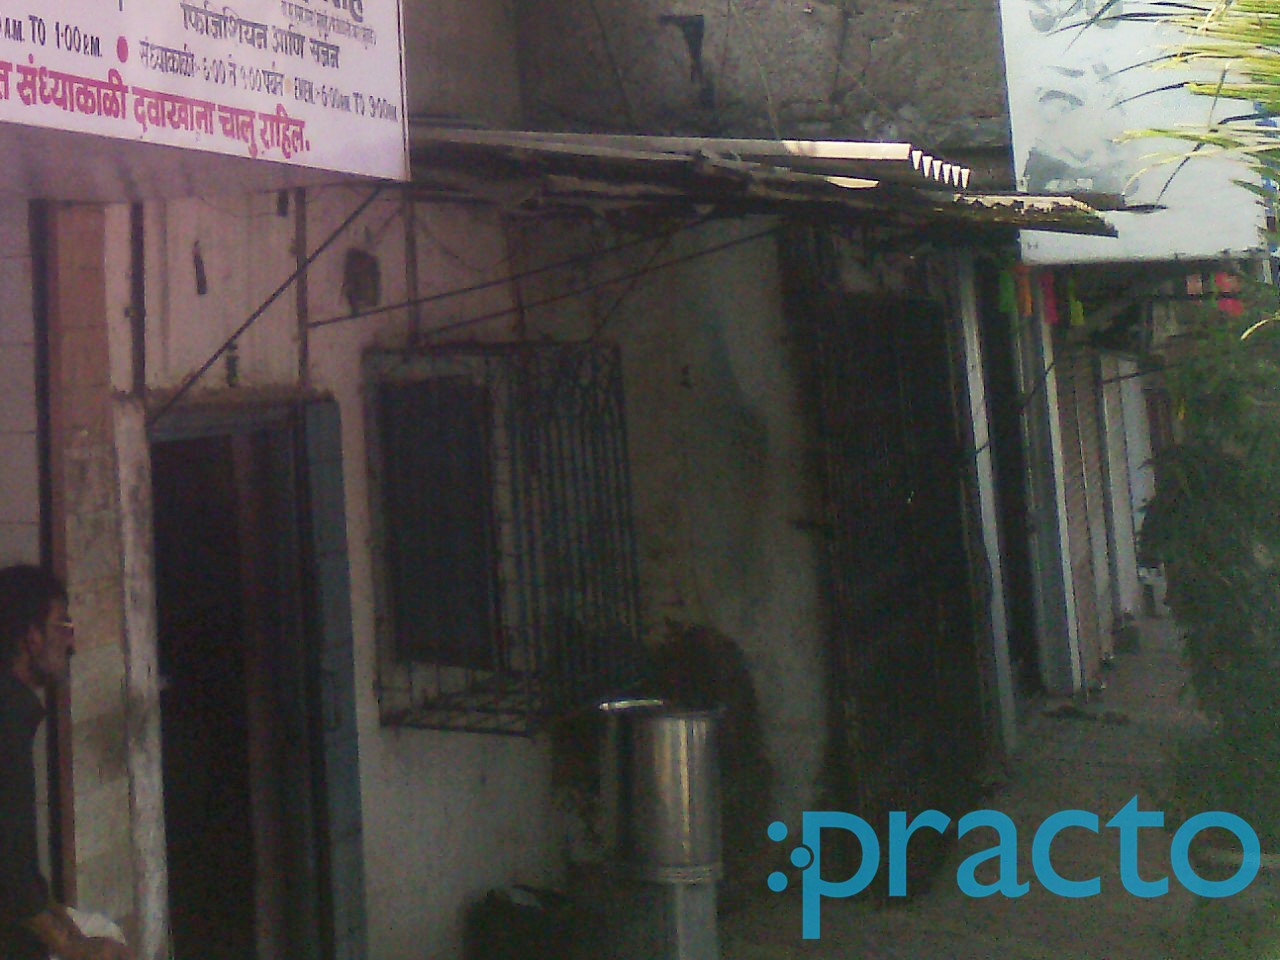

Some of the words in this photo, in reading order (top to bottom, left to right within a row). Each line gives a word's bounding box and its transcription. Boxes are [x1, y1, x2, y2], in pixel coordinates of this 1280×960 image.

[28, 14, 46, 46] TO
[16, 53, 129, 119] संध्याकाळी
[131, 86, 216, 135] दवाखाना
